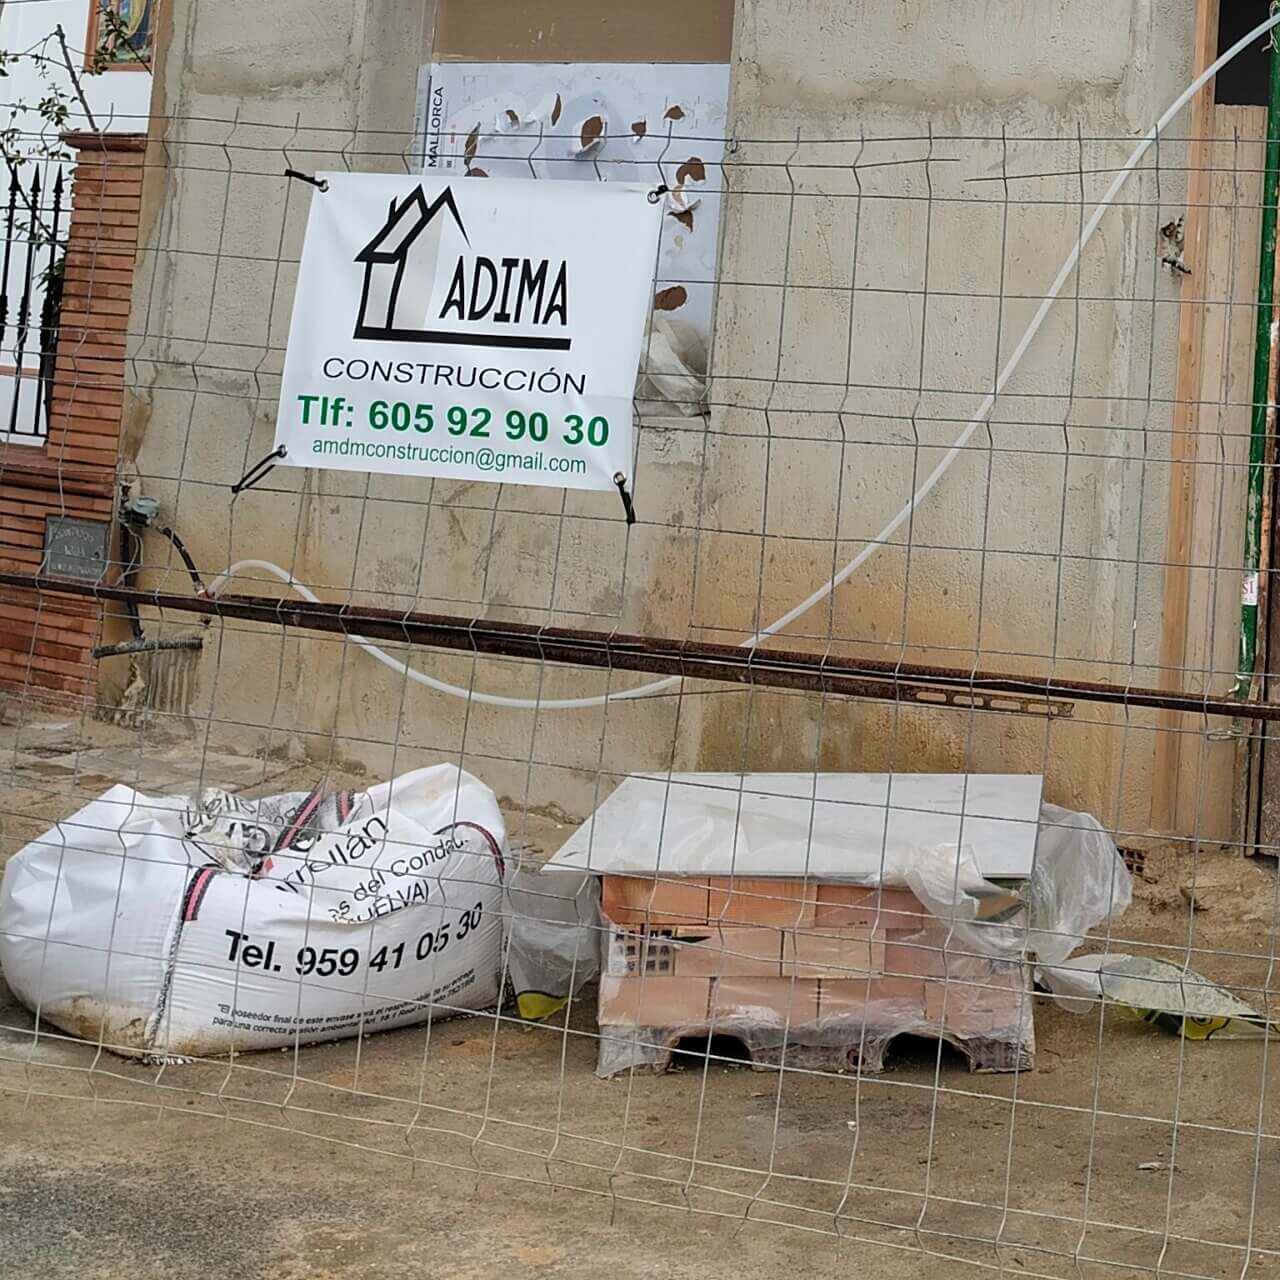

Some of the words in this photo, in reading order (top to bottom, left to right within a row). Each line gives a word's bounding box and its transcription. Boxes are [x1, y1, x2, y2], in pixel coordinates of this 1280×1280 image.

[428, 86, 444, 168] MALLORCA
[438, 255, 568, 326] ADIMA
[322, 357, 587, 395] CONSTRUCCIÓN
[297, 395, 354, 427] Tlf:
[368, 400, 434, 433] 605
[446, 406, 492, 438] 92
[505, 410, 549, 442] 90
[562, 414, 610, 447] 30
[312, 438, 587, 474] amdmconstruccion@gmail.com
[353, 870, 386, 901] del
[225, 929, 282, 972] Tel.
[296, 946, 360, 977] 959
[369, 942, 406, 972] 41
[416, 923, 450, 961] 05
[456, 901, 483, 941] 30
